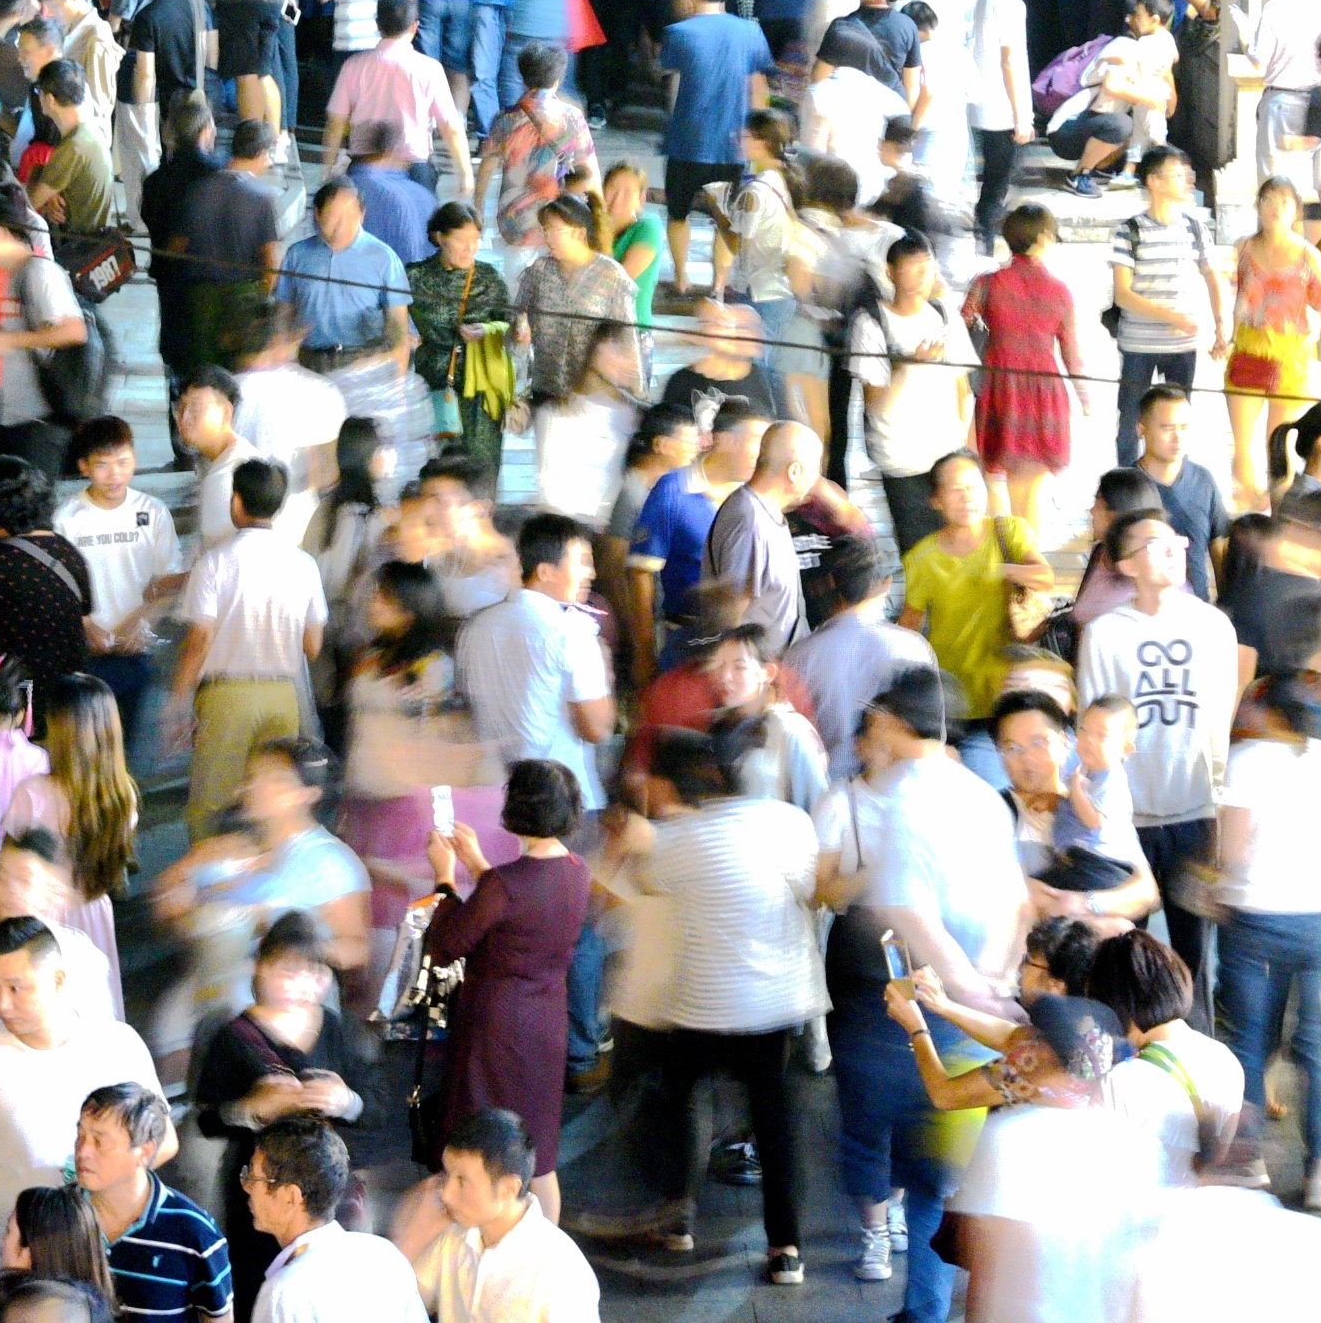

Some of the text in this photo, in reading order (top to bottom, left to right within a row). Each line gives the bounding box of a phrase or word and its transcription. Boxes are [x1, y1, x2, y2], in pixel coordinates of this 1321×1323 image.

[89, 254, 121, 291] 1987
[96, 533, 112, 545] YOU
[114, 531, 140, 544] COLD?
[1136, 638, 1193, 667] GO
[1134, 668, 1197, 698] ALL
[1135, 699, 1200, 730] OUT
